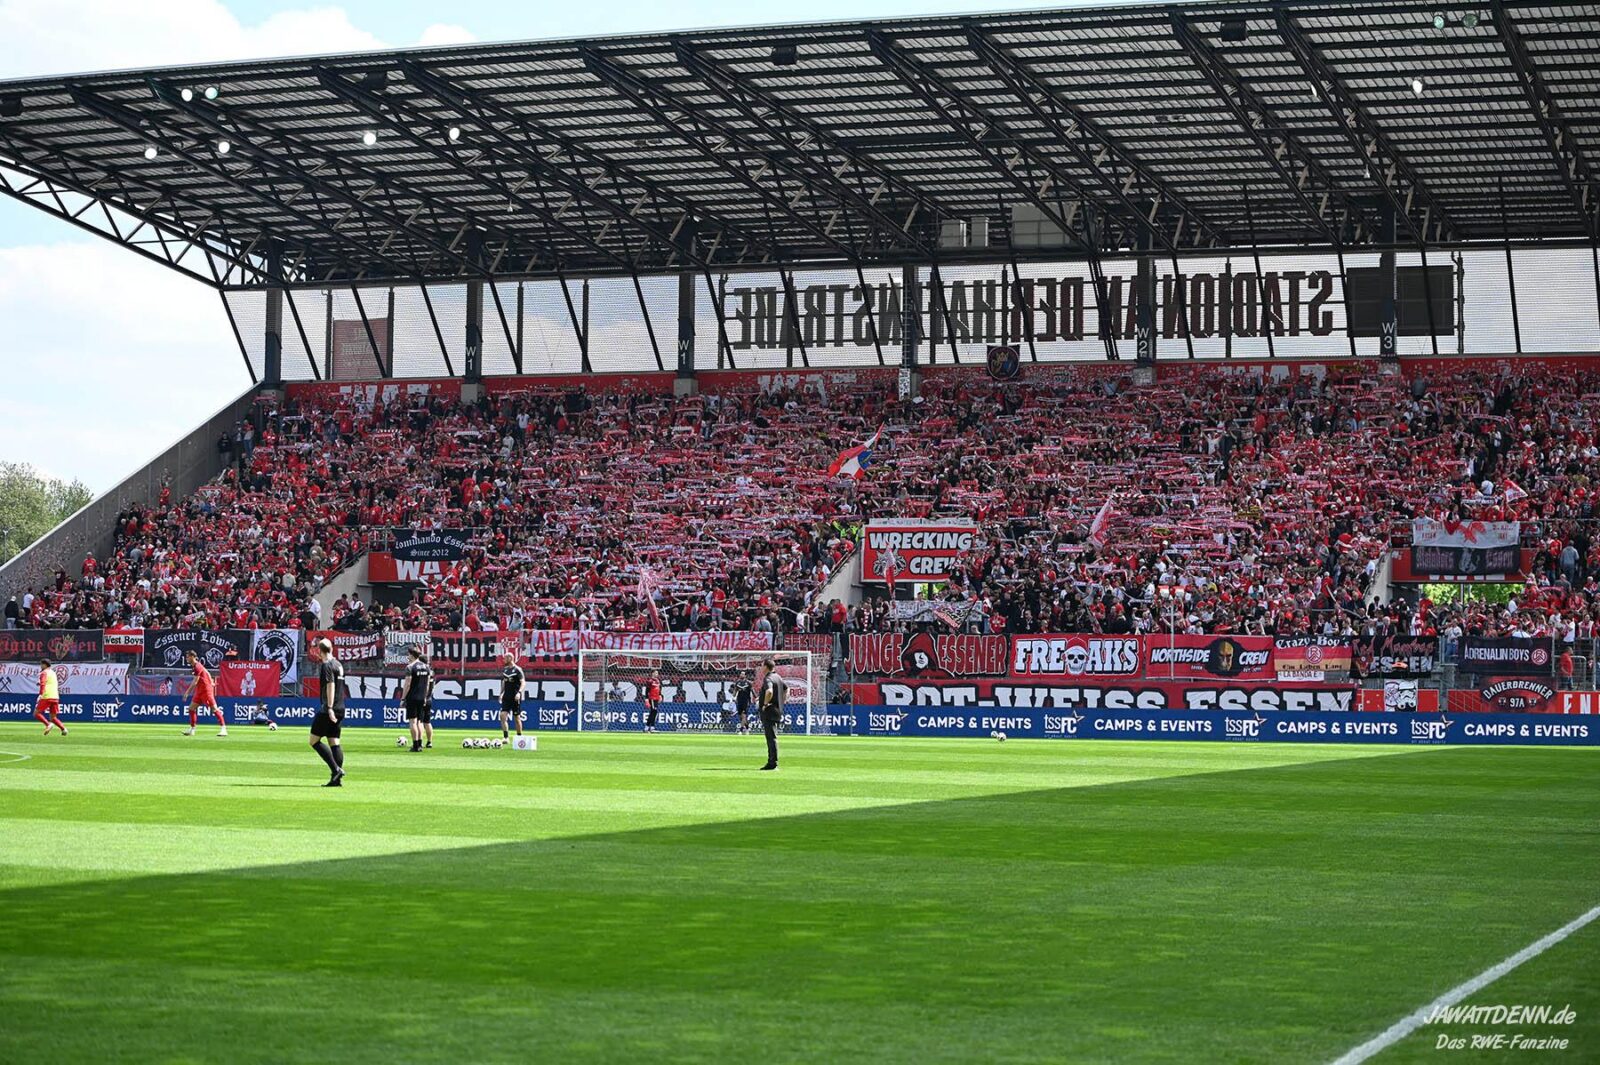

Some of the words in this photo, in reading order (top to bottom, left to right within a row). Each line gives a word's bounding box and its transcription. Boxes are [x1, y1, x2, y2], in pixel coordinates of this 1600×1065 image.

[1382, 322, 1395, 334] W
[1384, 336, 1393, 349] 3
[869, 531, 973, 550] WRECKING
[431, 549, 449, 557] 2012
[104, 635, 125, 645] West
[125, 634, 144, 645] Boys
[154, 631, 197, 649] Essener
[200, 629, 231, 649] Löwe
[534, 631, 573, 652] ALLE
[338, 645, 378, 660] ESSEN
[431, 636, 497, 662] RUDE
[844, 632, 903, 675] JUNGE
[937, 633, 1008, 675] ESSENER
[1014, 638, 1139, 675] FREAKS
[1150, 648, 1211, 663] NORTHSIDE
[1239, 650, 1269, 665] CREW
[1464, 643, 1508, 661] ADRENALIN
[1509, 648, 1531, 661] BOYS
[0, 663, 41, 678] Ruhrpo
[70, 664, 126, 677] Kanaken
[881, 683, 1166, 709] ROT-WEISS
[1186, 689, 1353, 712] ESSEN
[1482, 680, 1554, 700] DAUERBRENNER
[0, 703, 31, 714] AMPS
[1509, 697, 1525, 708] 97A
[131, 705, 170, 715] CAMPS
[172, 705, 180, 715] &
[183, 706, 224, 717] EENS
[234, 703, 258, 720] tssF
[275, 707, 315, 718] CAMPS
[344, 708, 373, 719] ENTS
[429, 709, 467, 721] CAMPS
[471, 710, 480, 720] &
[538, 706, 569, 725] tssFC
[631, 713, 638, 723] &
[796, 715, 805, 726] &
[810, 715, 857, 727] EVENTS
[868, 711, 901, 731] tssFC
[918, 717, 964, 729] CAMPS
[968, 718, 978, 729] &
[982, 717, 1032, 730] EVENTS
[1044, 714, 1077, 734] tssFC
[1094, 719, 1143, 731] CAMPS
[1147, 720, 1156, 731] &
[1161, 720, 1212, 732] EVENTS
[1225, 716, 1259, 737] tssFC
[1276, 721, 1327, 734] CAMPS
[1331, 722, 1341, 734] &
[1345, 722, 1398, 735] EVENTS
[1410, 719, 1446, 739] tssFC
[1464, 723, 1515, 736] CAMPS
[1520, 724, 1529, 736] &
[1534, 725, 1589, 738] EVENTS
